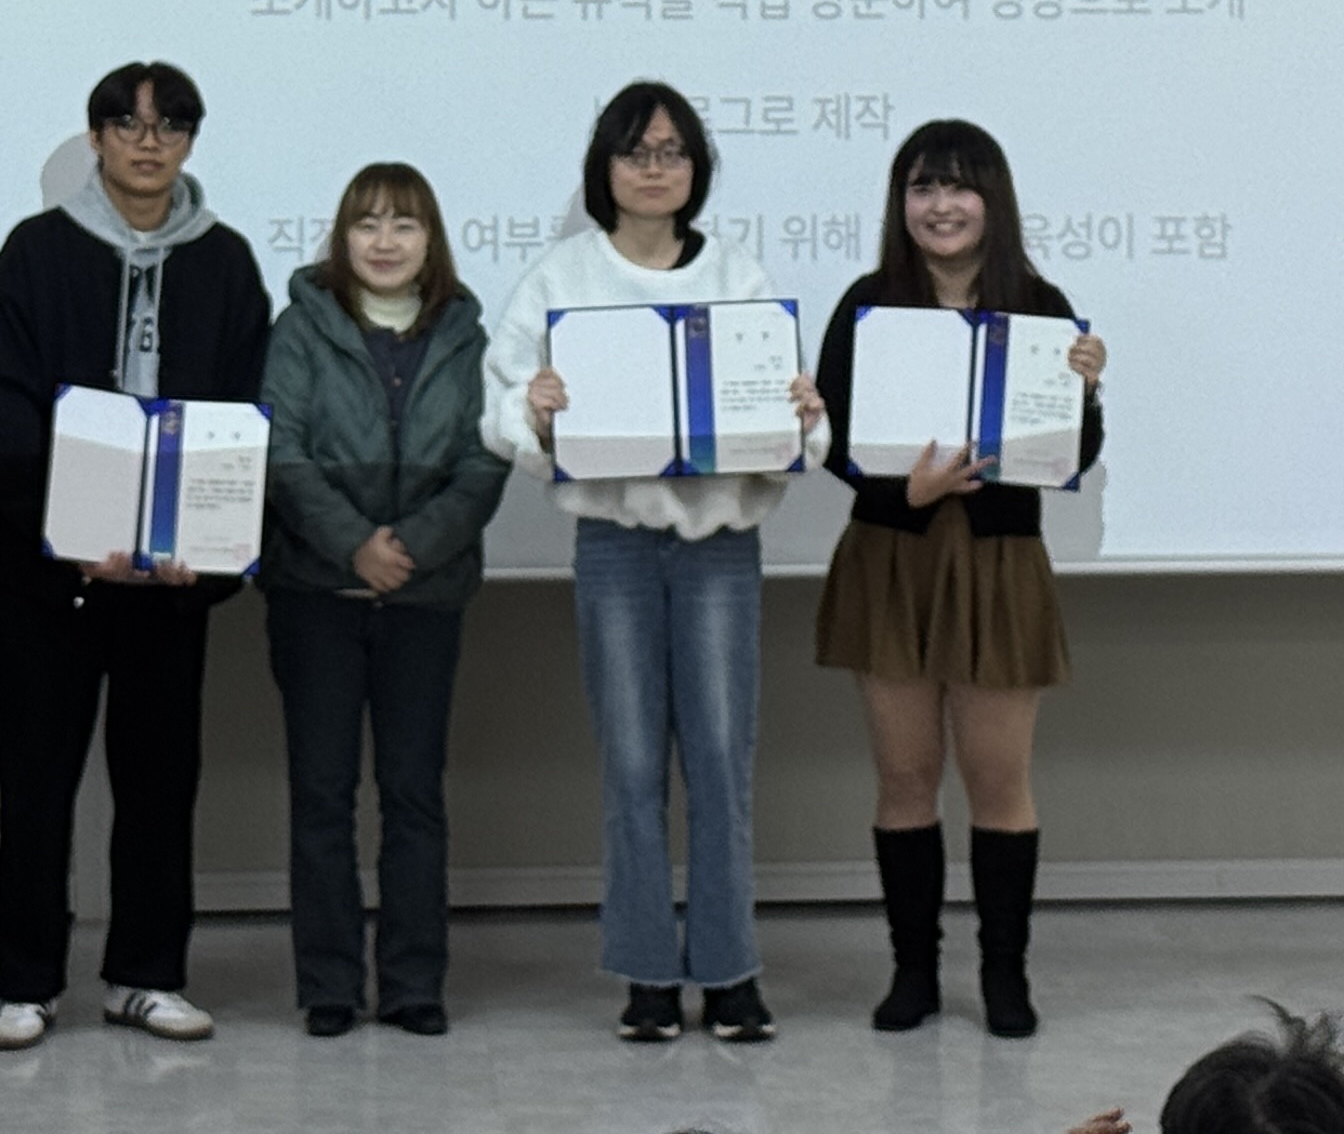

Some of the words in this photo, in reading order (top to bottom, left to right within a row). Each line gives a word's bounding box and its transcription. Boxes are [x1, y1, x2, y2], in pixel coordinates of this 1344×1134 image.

[812, 91, 896, 141] 제작
[461, 214, 568, 263] 여부
[779, 214, 861, 261] 위해
[1022, 212, 1136, 261] 육성이
[1149, 212, 1233, 260] 포함
